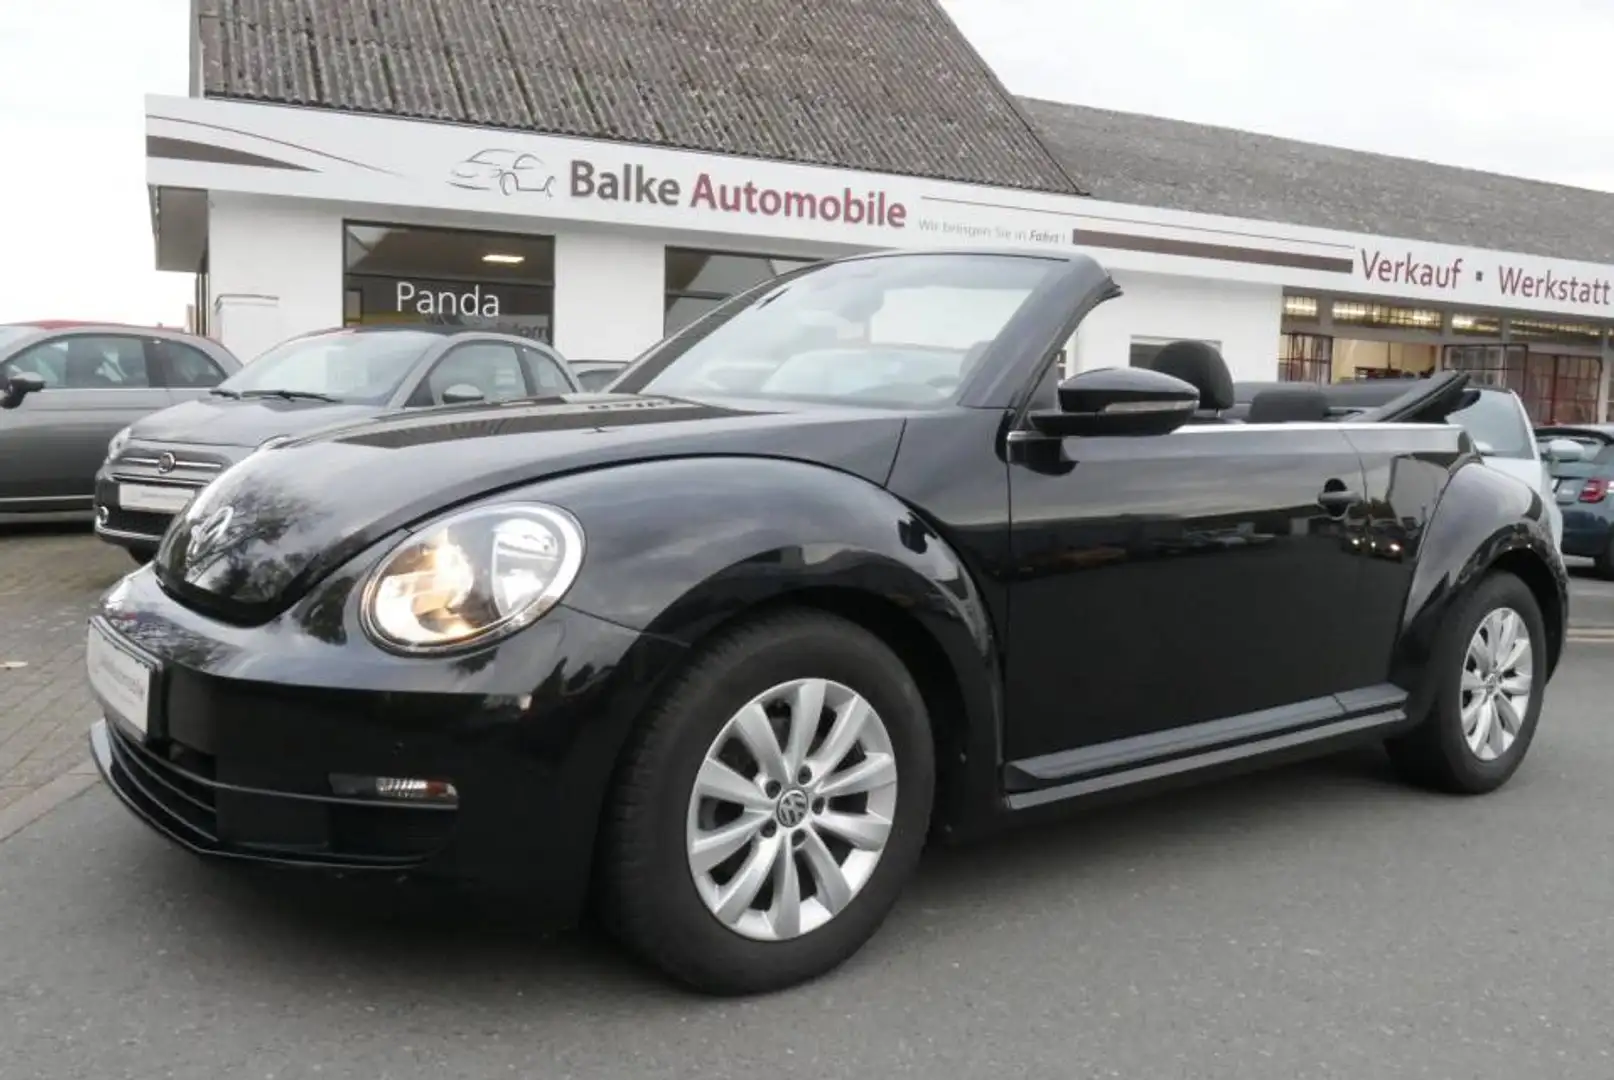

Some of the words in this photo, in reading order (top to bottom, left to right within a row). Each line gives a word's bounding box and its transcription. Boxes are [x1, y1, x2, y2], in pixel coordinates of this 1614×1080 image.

[570, 159, 681, 206] Balke
[690, 173, 907, 228] Automobile
[918, 218, 938, 231] Wir
[396, 281, 500, 318] Panda
[1361, 248, 1464, 289] Verkauf
[1498, 265, 1612, 306] Werkstatt
